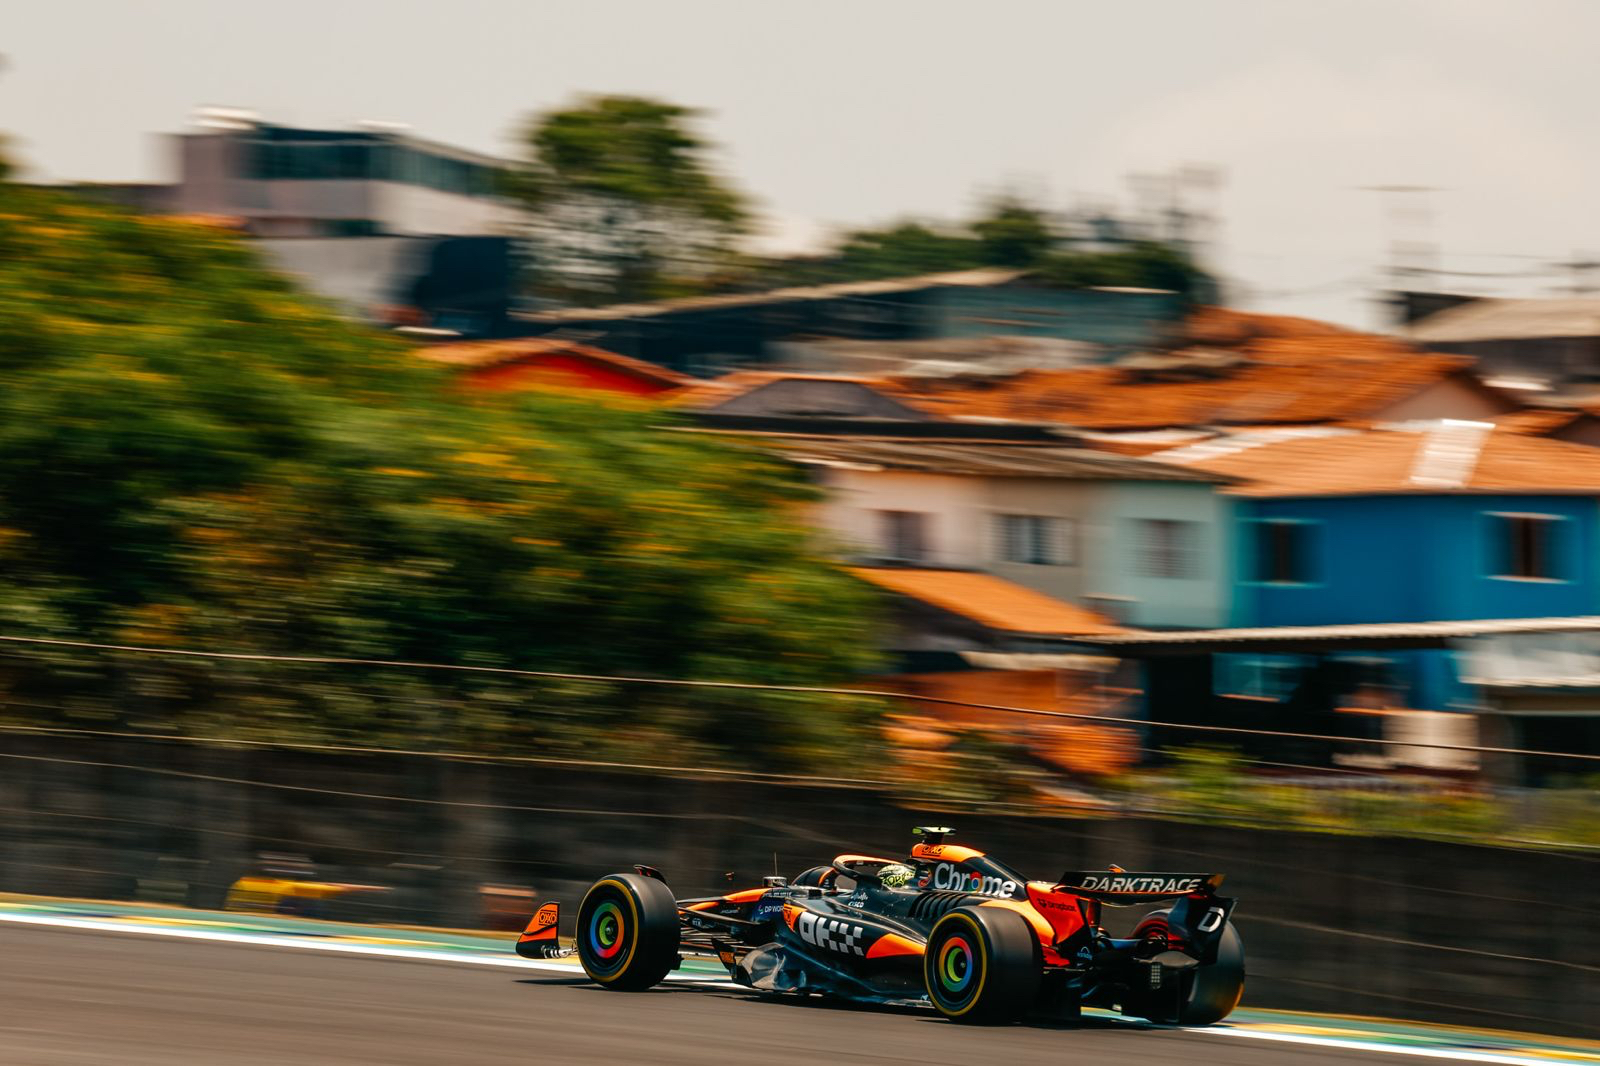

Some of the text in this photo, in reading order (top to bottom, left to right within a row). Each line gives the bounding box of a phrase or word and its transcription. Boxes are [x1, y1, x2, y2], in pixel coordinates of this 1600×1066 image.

[934, 863, 1016, 898] Chrome
[1080, 877, 1202, 893] DARKTRACE
[799, 912, 864, 956] OKX
[1197, 907, 1224, 932] D
